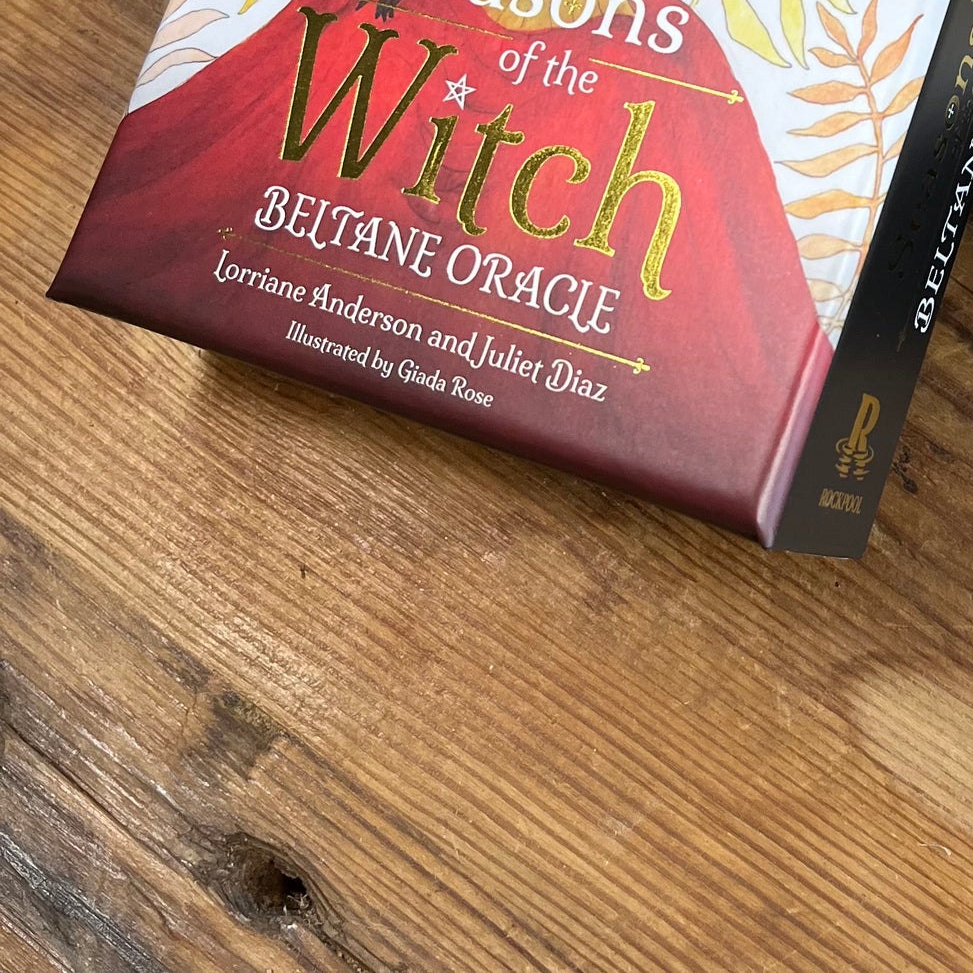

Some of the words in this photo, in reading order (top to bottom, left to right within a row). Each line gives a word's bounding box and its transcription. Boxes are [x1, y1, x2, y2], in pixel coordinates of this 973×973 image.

[499, 42, 539, 87] of
[546, 49, 599, 94] the
[279, 5, 684, 301] Witch
[253, 184, 442, 278] BELTANE
[446, 244, 621, 334] ORACLE
[212, 248, 306, 303] Lorriane
[307, 283, 423, 342] Anderson
[427, 329, 477, 363] and
[470, 335, 544, 384] Juliet
[546, 358, 608, 402] Diaz
[285, 319, 371, 370] Illustrated
[371, 350, 394, 378] by
[397, 358, 446, 393] Giada
[451, 375, 494, 408] Rose
[818, 488, 864, 515] ROCKPOOL
